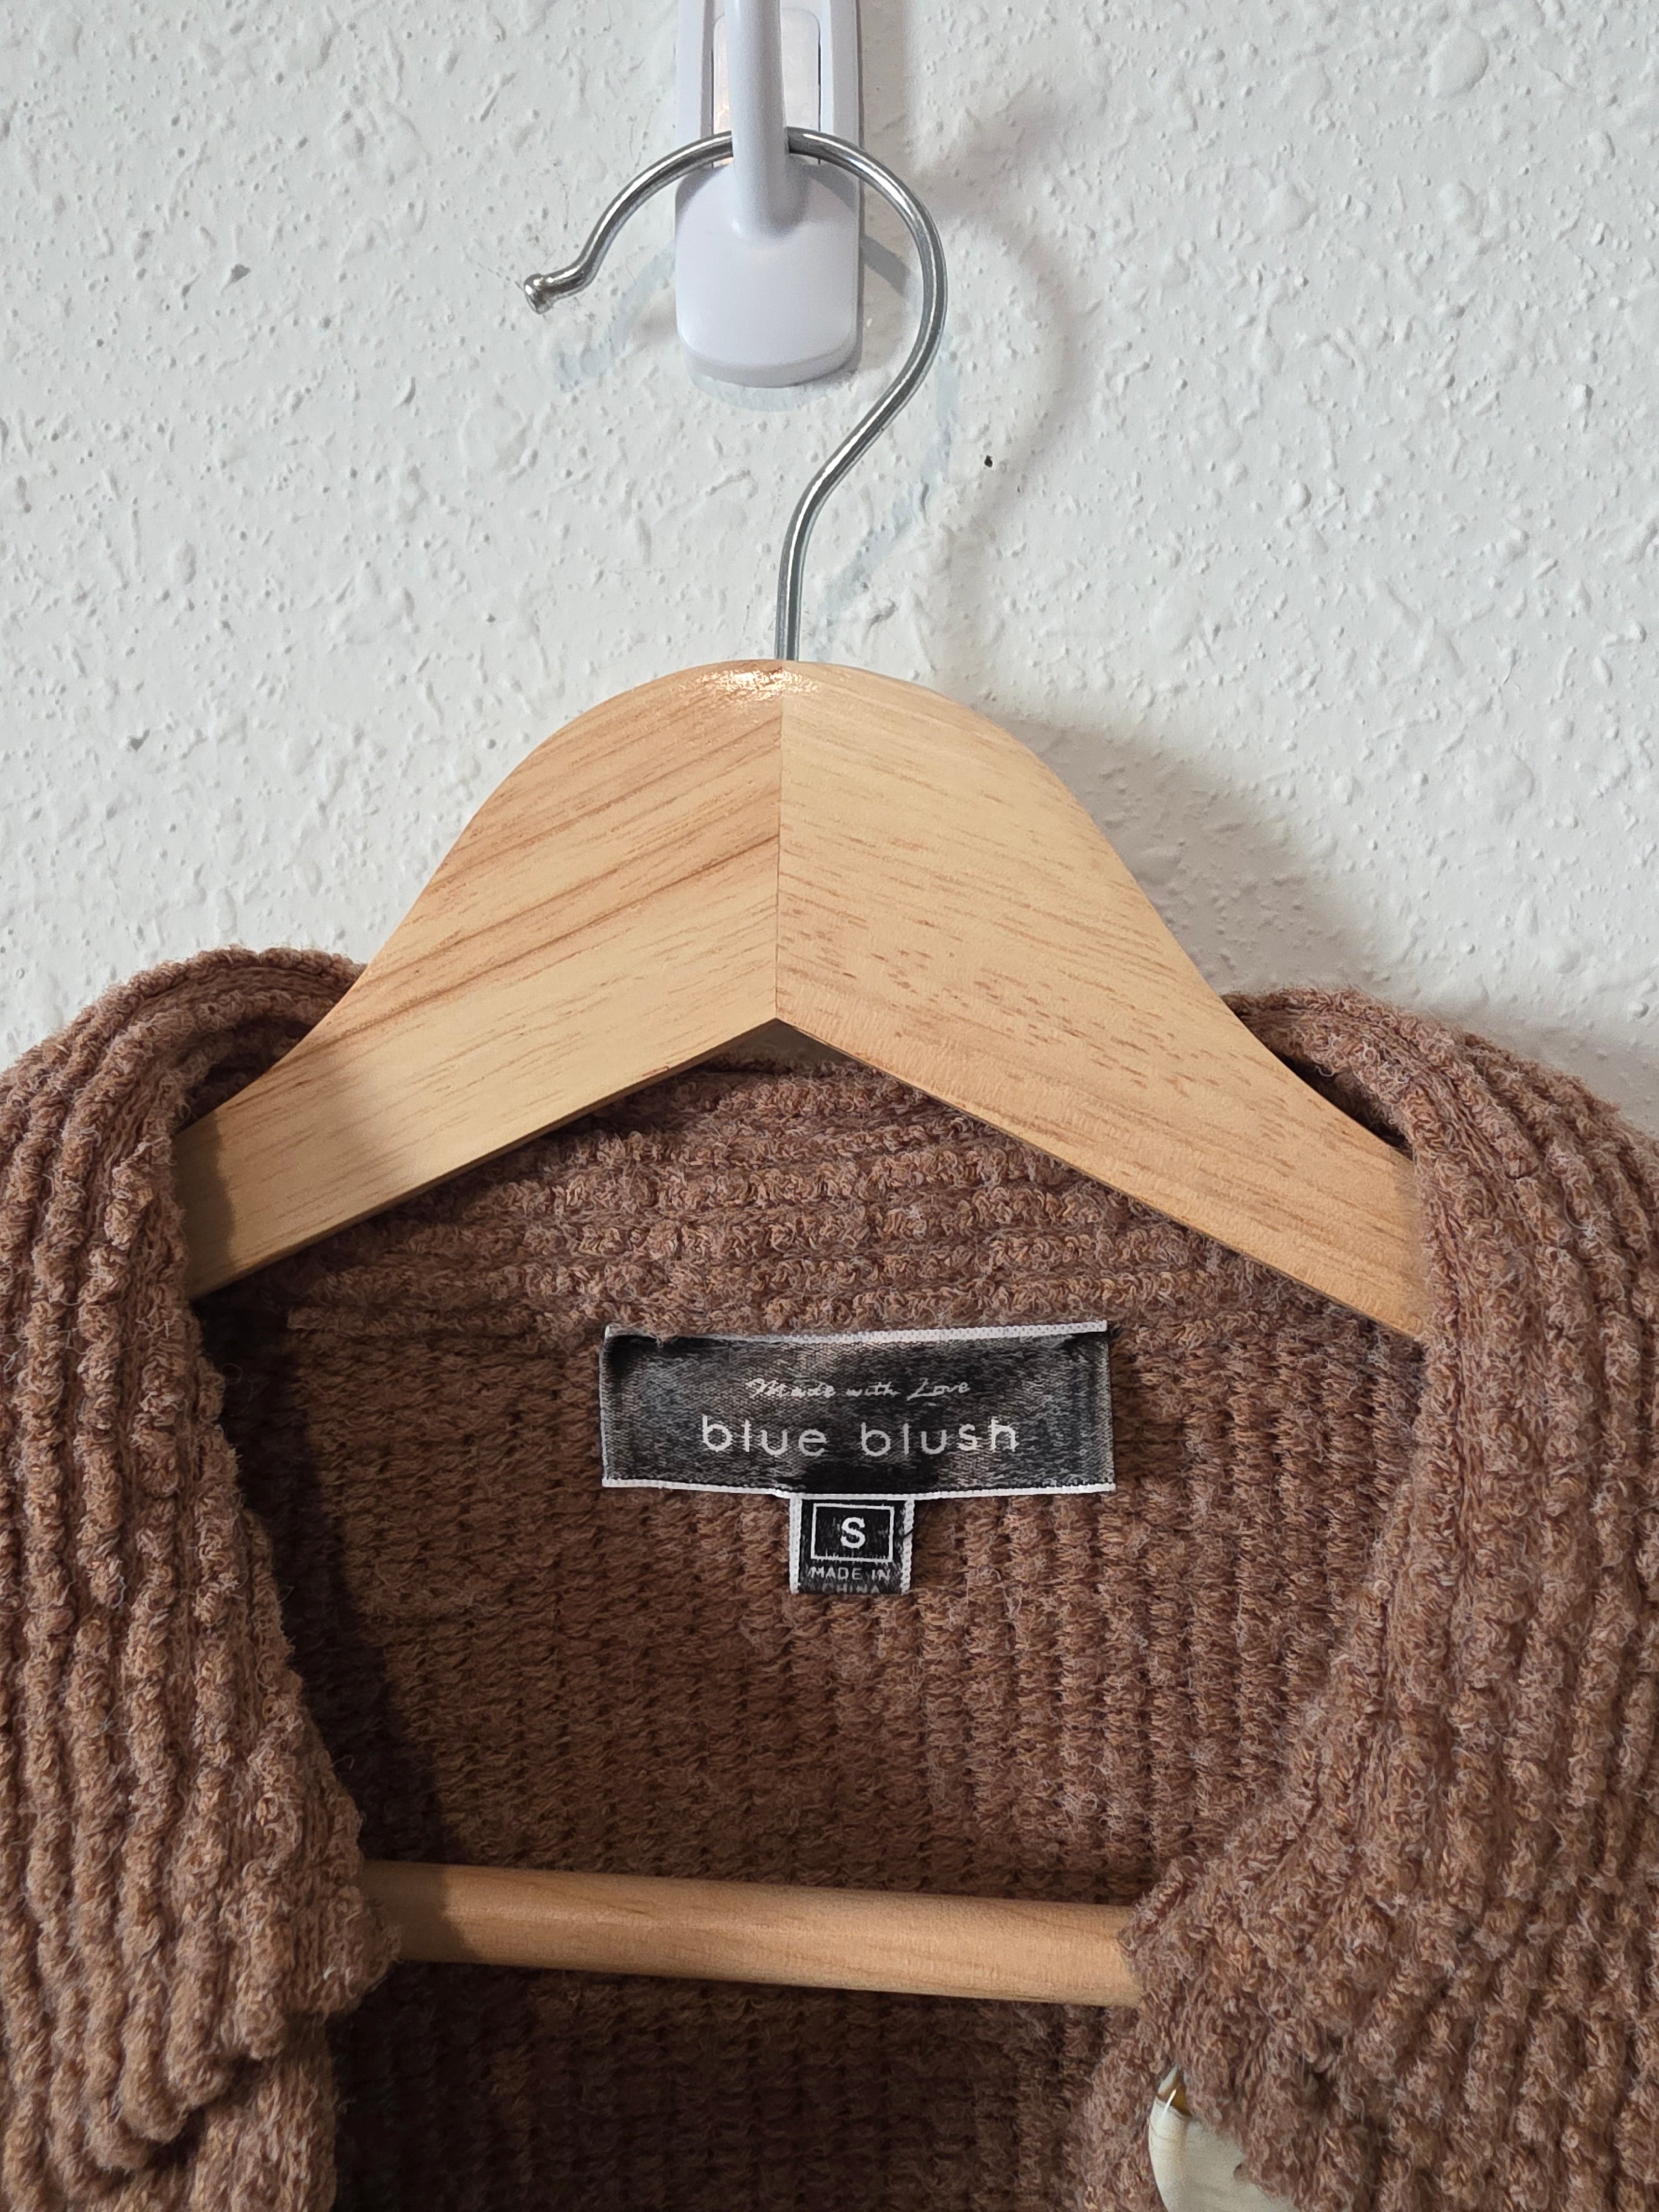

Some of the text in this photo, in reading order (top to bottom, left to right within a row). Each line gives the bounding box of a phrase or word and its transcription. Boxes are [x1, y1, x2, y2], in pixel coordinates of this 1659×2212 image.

[745, 1377, 971, 1401] Made with Love
[701, 1413, 1019, 1457] blue blush
[840, 1516, 866, 1550] S
[807, 1566, 891, 1581] MADE IN
